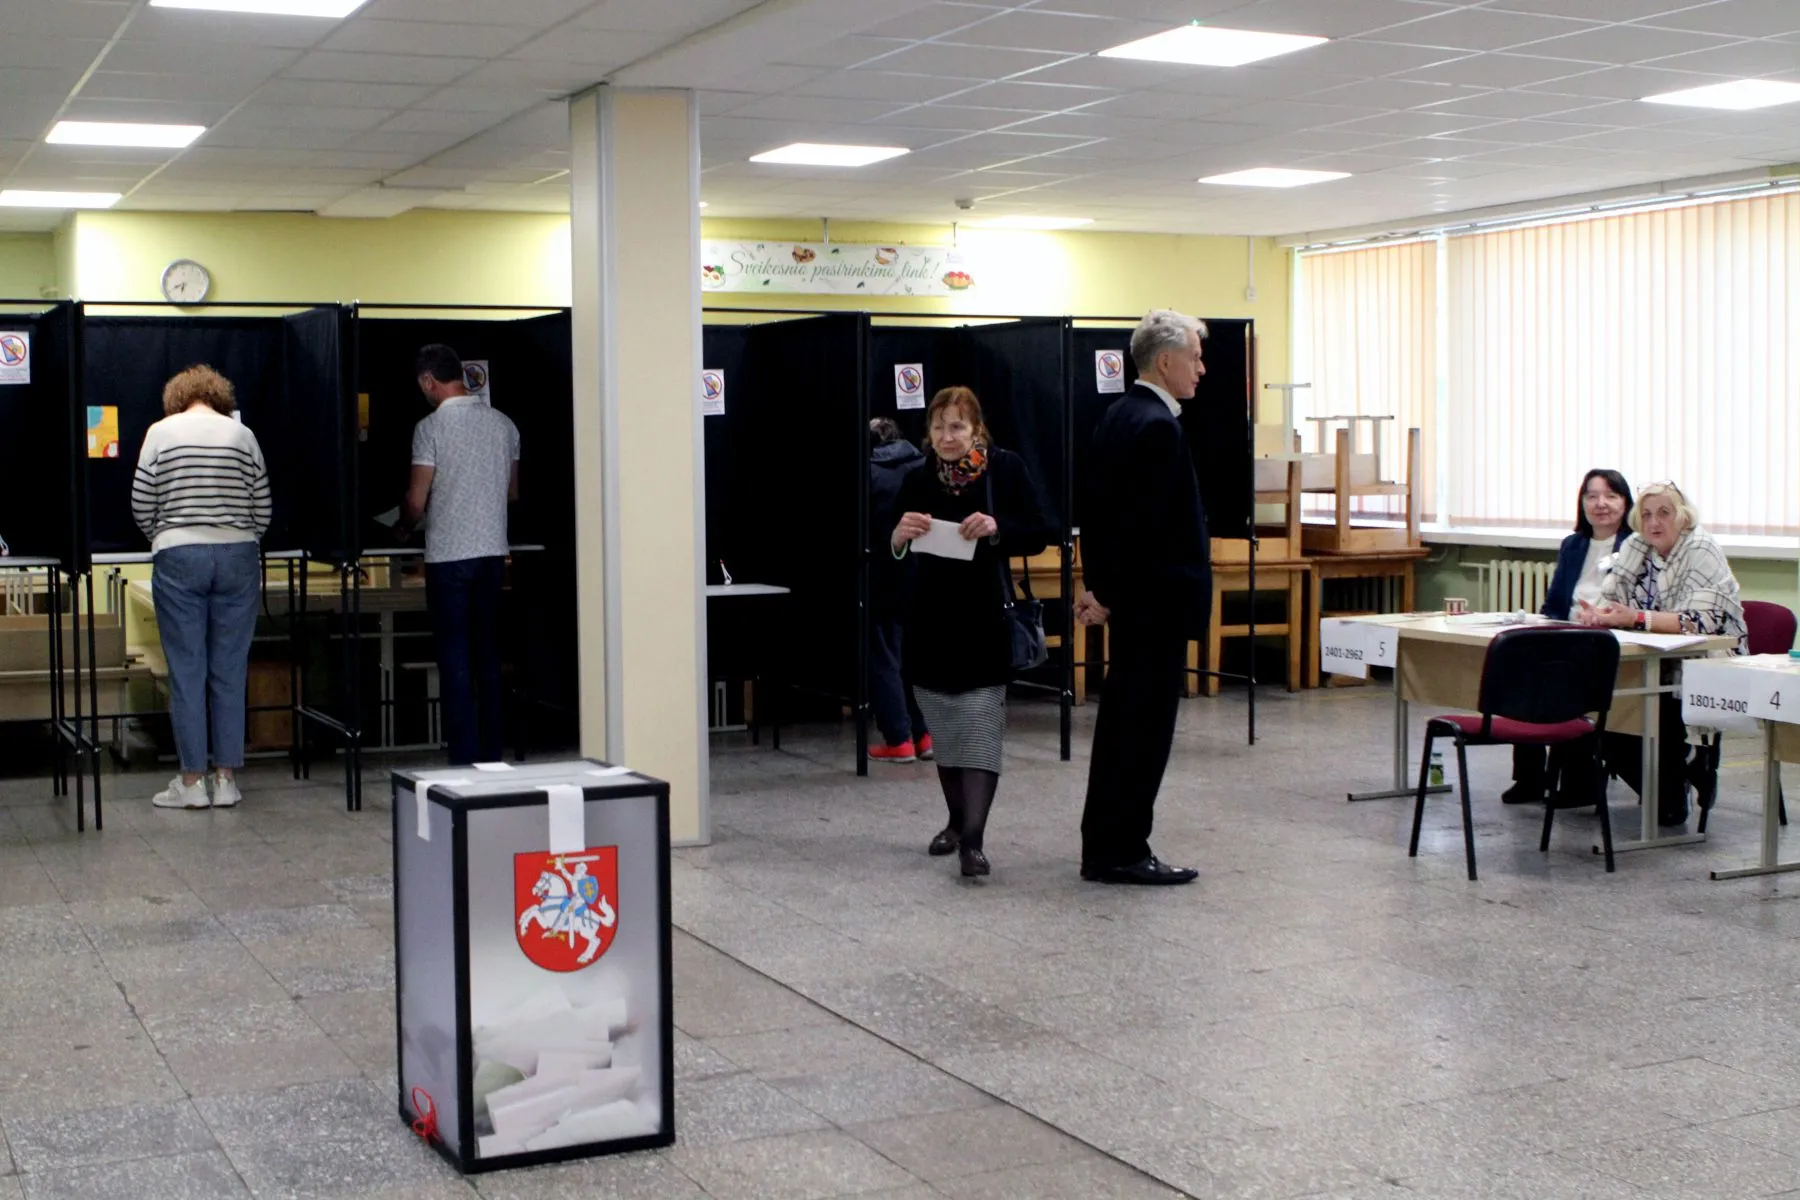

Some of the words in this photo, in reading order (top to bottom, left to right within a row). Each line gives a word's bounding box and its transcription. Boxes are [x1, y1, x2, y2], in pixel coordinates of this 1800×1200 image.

[810, 259, 896, 283] pasirinkimo
[901, 260, 940, 279] link!
[1325, 646, 1363, 660] 2401-2962
[1379, 641, 1386, 657] 5
[1690, 694, 1748, 713] 1801-2400
[1770, 691, 1781, 710] 4
